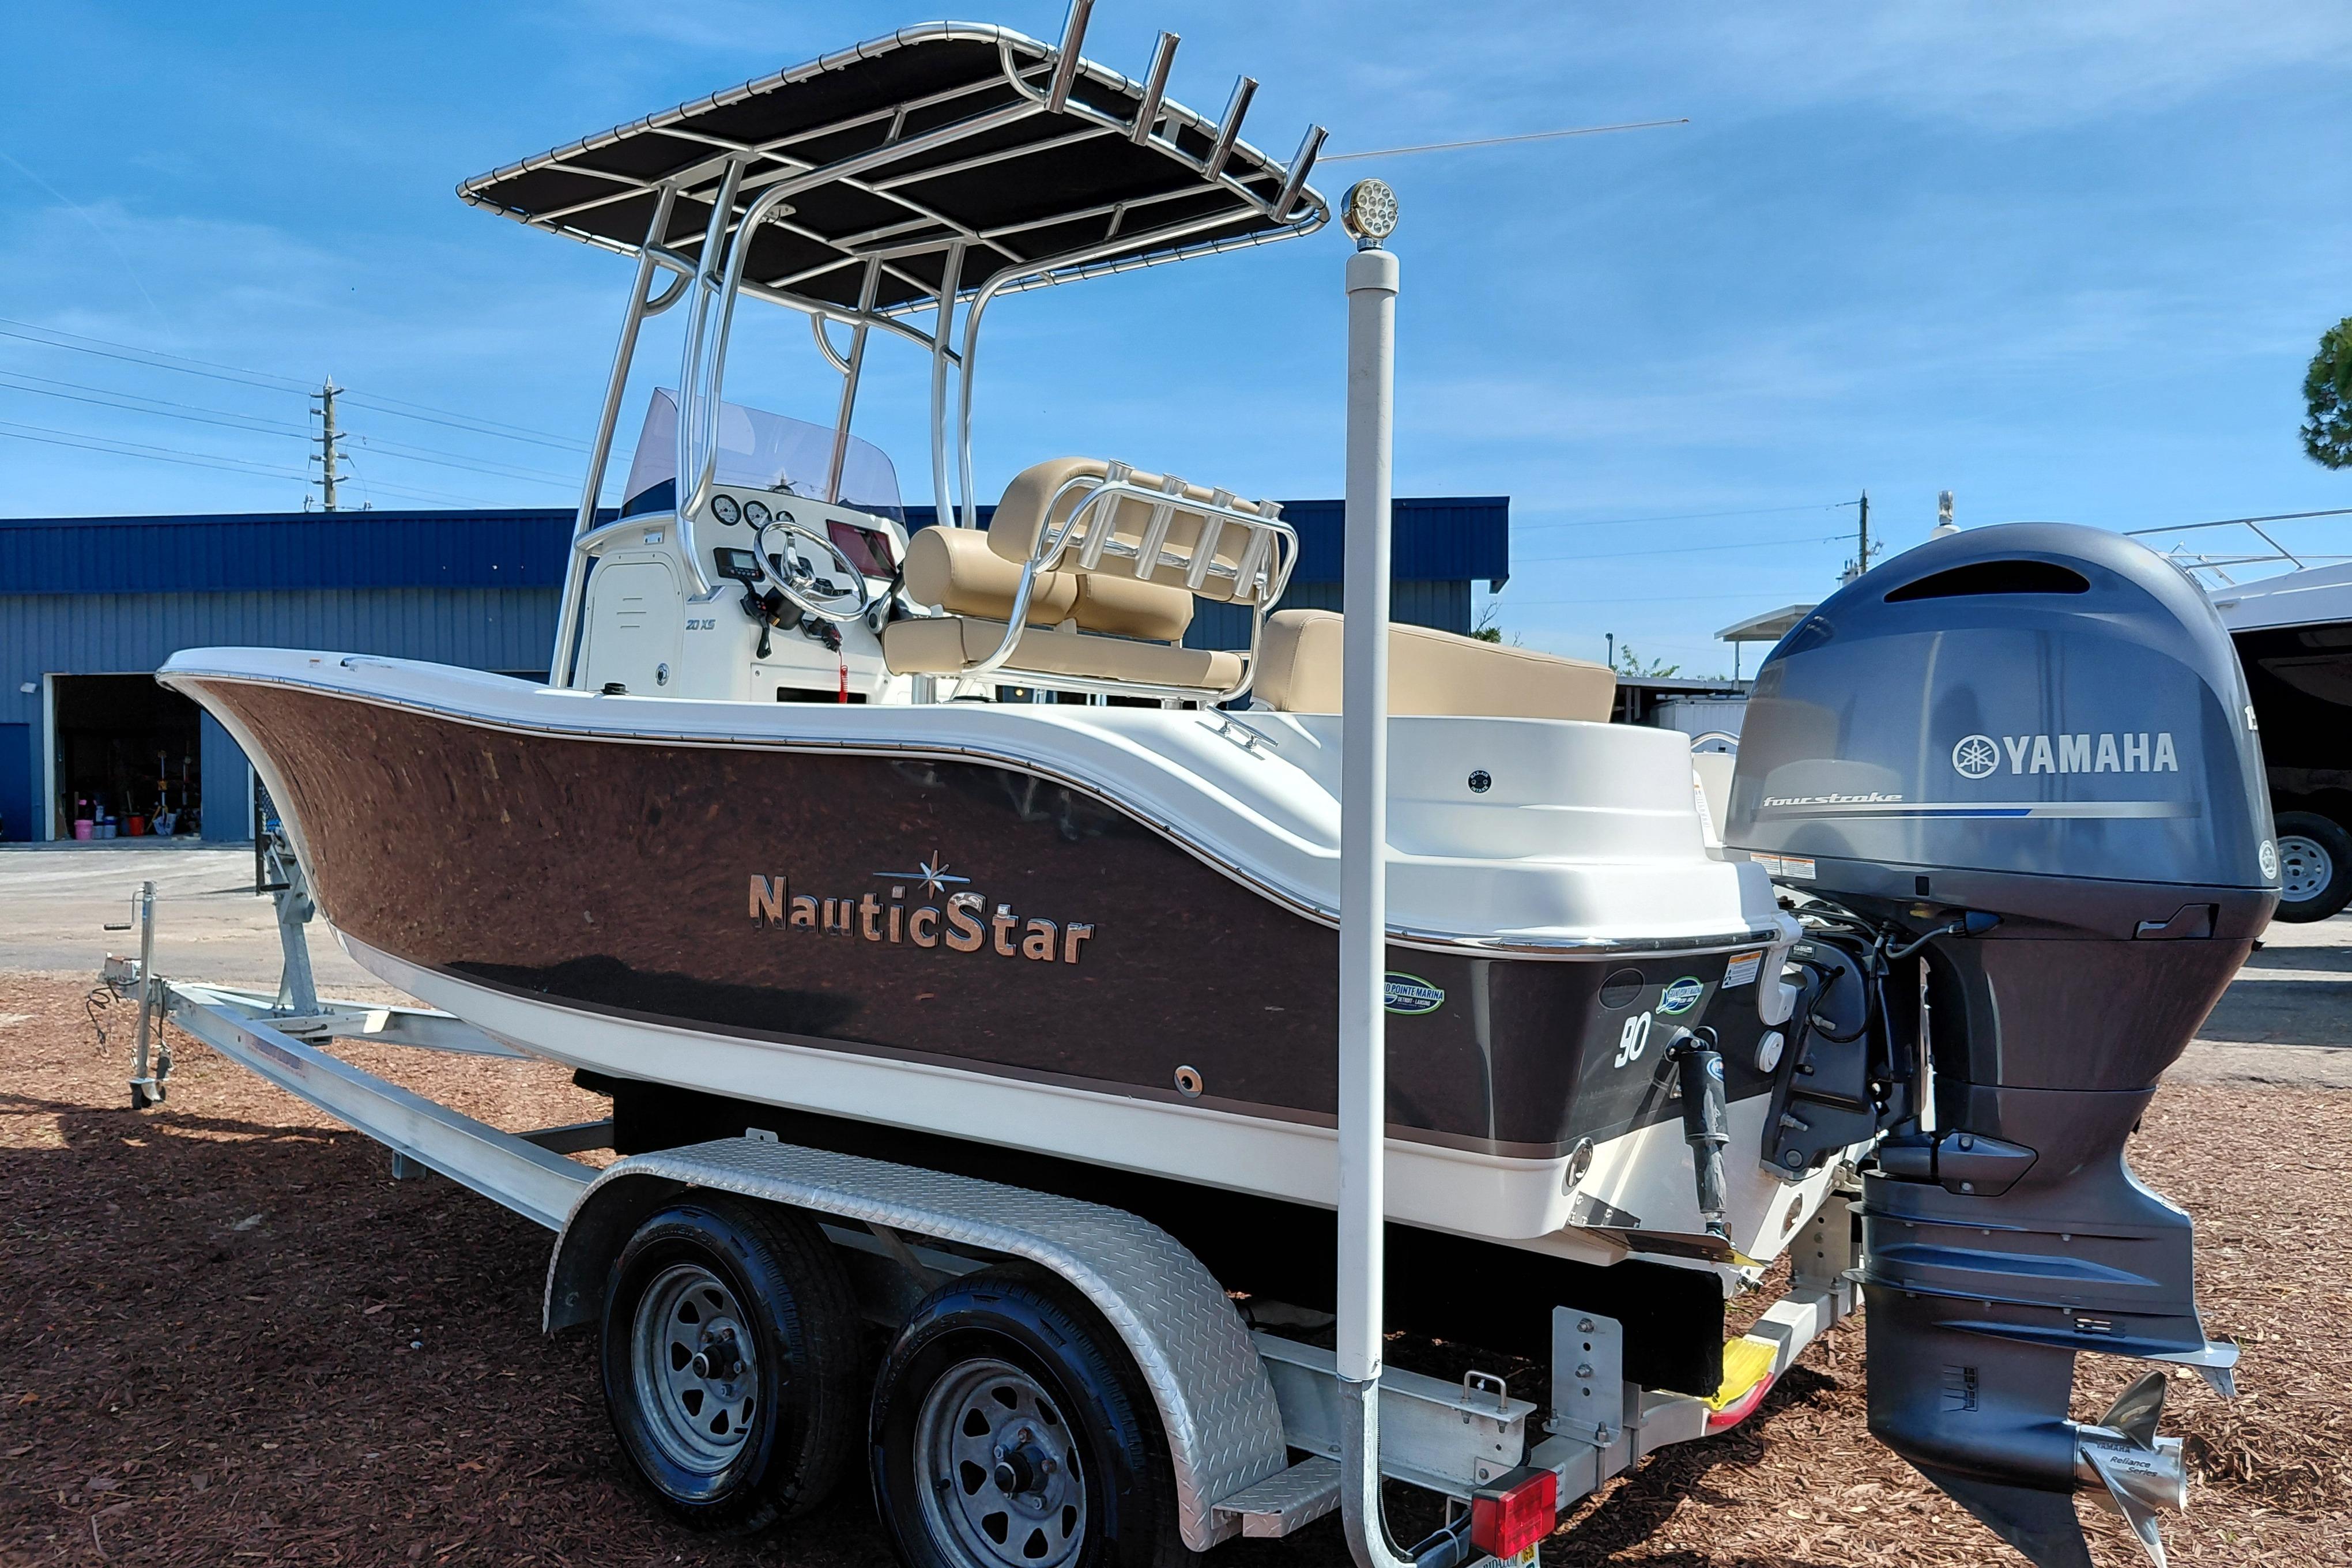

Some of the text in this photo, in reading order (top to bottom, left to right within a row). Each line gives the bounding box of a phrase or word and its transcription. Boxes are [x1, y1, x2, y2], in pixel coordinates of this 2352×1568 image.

[685, 619, 716, 630] 20 XS
[2003, 733, 2178, 775] YAMAHA
[749, 874, 1094, 964] NauticStar
[1392, 984, 1416, 997] POINTE
[1416, 987, 1443, 1000] MARINA
[1614, 1011, 1651, 1068] 90
[2110, 1456, 2151, 1468] Reliance
[2126, 1467, 2158, 1477] Series
